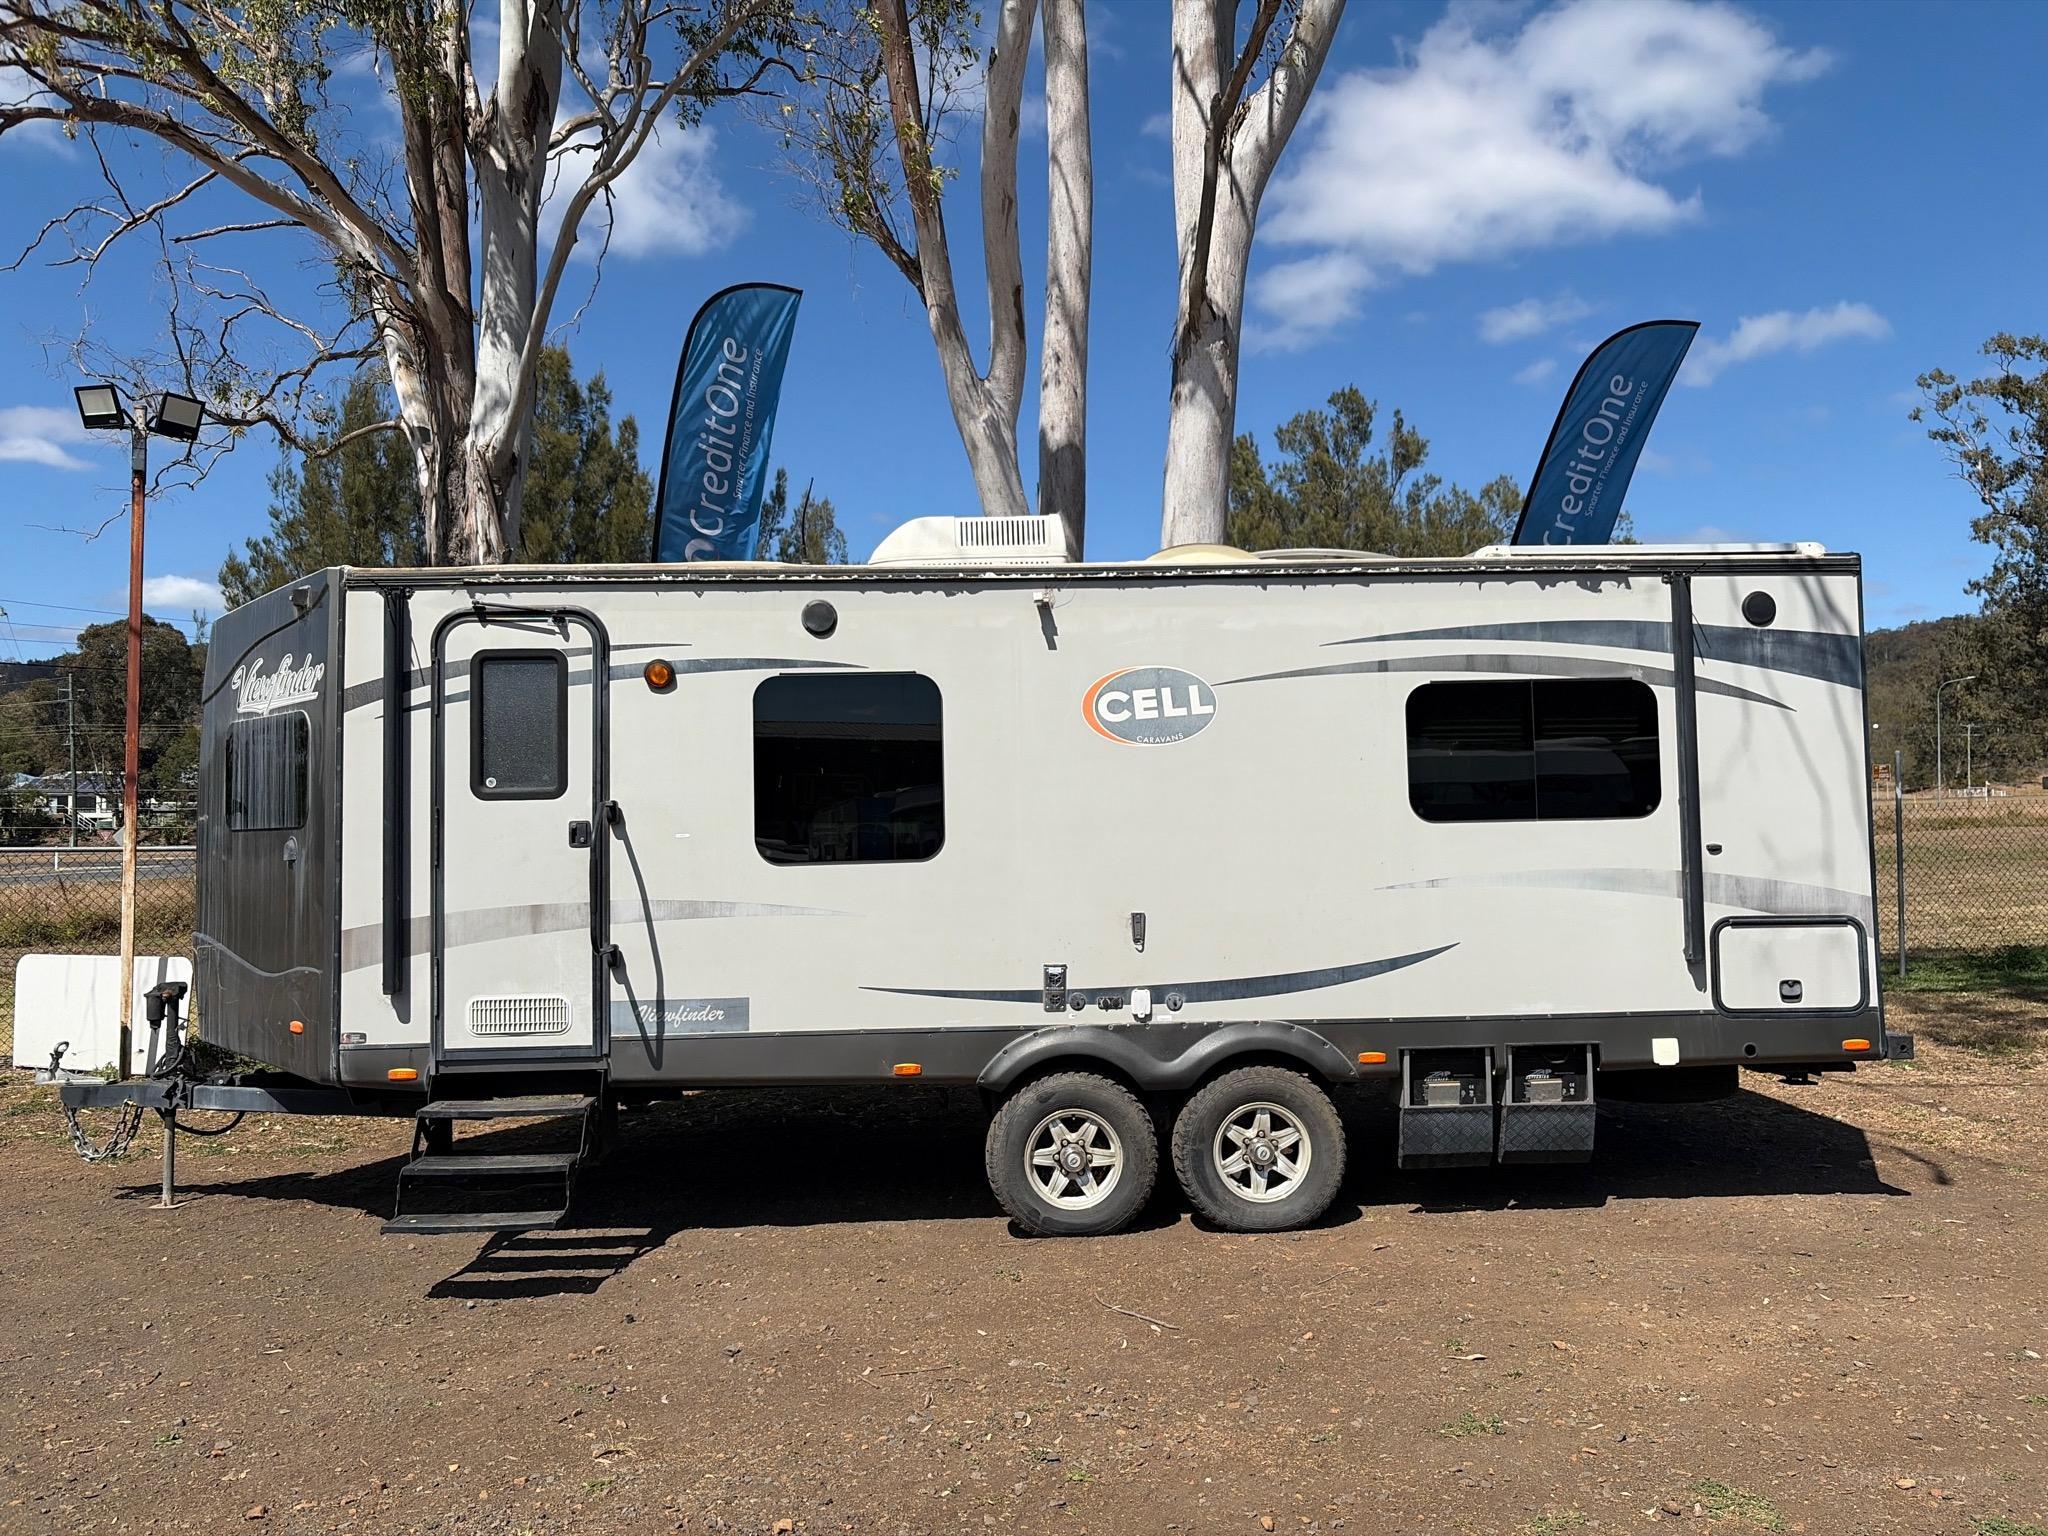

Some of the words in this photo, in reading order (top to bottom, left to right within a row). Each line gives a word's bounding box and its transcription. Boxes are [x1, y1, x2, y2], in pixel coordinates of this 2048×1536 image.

[746, 348, 763, 399] Insurance
[745, 398, 755, 419] and
[690, 337, 748, 536] CreditOne
[739, 420, 752, 458] Finance
[1584, 481, 1603, 517] Smarter
[1599, 446, 1619, 479] Finance
[1617, 426, 1628, 445] and
[1623, 381, 1648, 426] Insurance
[733, 460, 746, 500] Smarter
[231, 652, 325, 717] Viewfinder
[1097, 684, 1214, 723] CELL
[636, 1004, 725, 1028] Viewfinder
